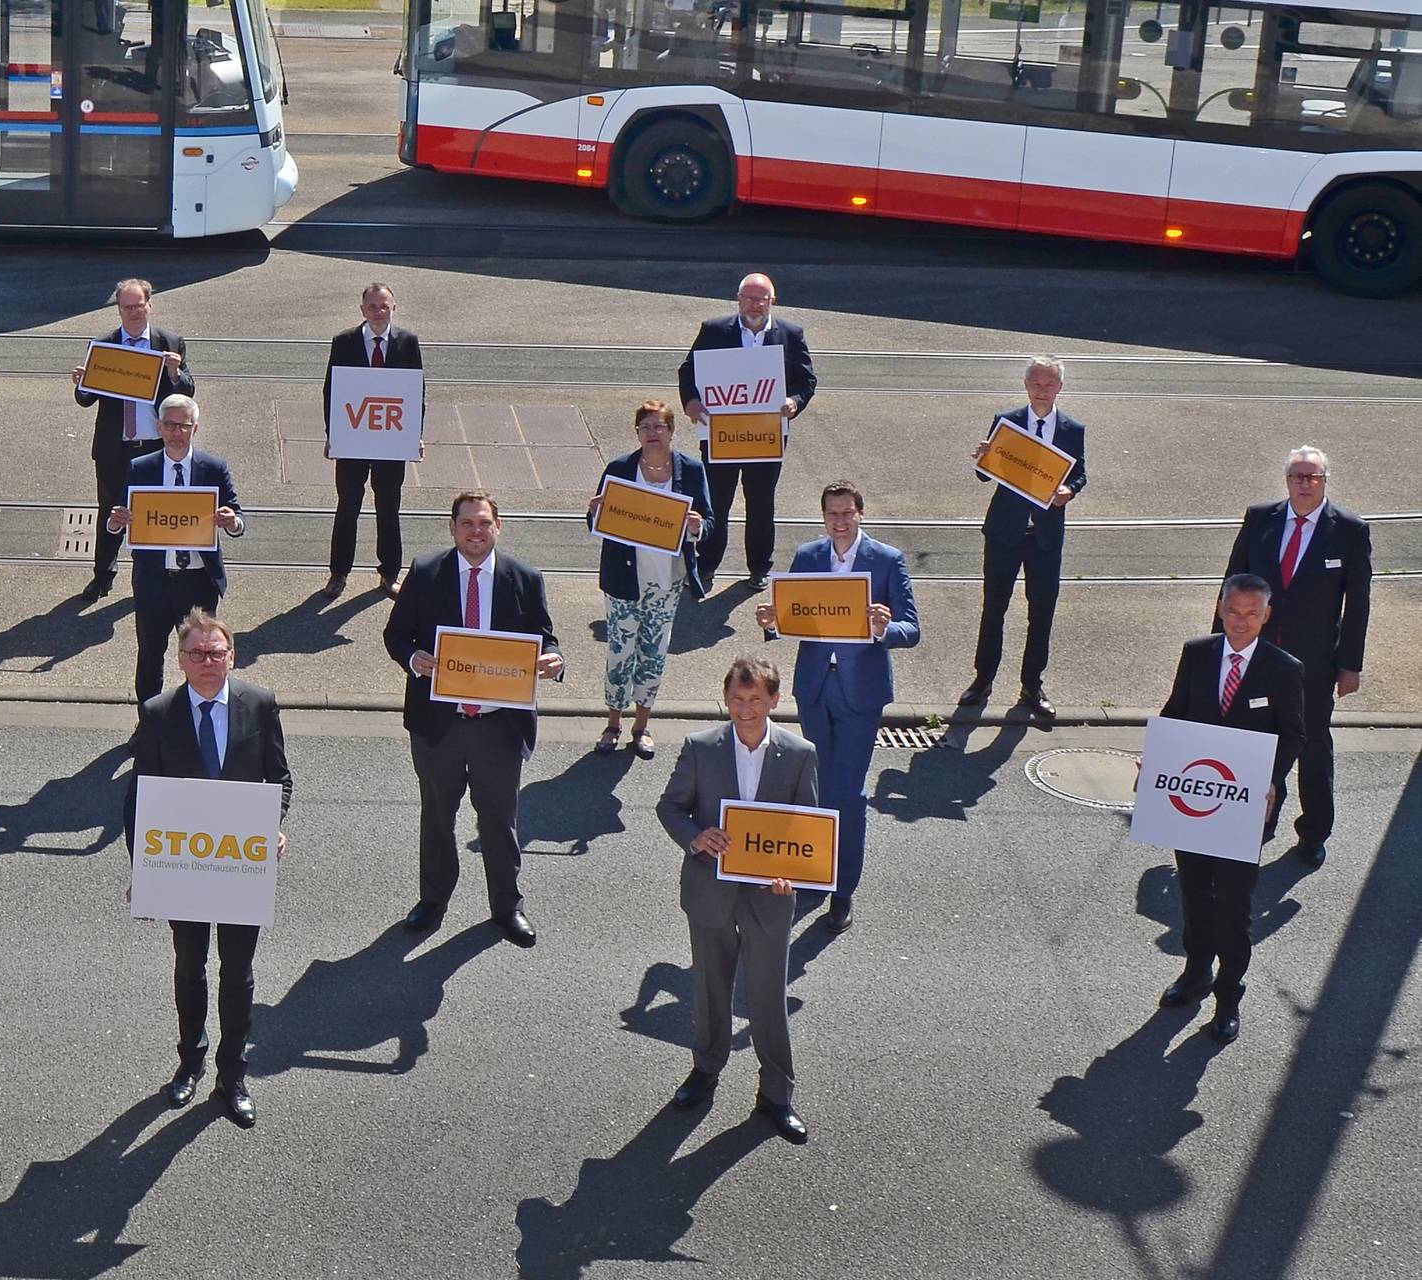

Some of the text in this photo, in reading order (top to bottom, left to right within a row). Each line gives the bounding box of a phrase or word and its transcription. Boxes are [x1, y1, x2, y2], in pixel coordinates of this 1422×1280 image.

[345, 397, 404, 431] VER
[719, 430, 776, 444] Duisburg
[995, 446, 1054, 482] Gelsenkirchen
[147, 510, 199, 529] Hagen
[609, 505, 675, 529] Metropole Ruhr
[791, 602, 851, 616] Bochum
[446, 659, 527, 679] Oberhausen
[1155, 773, 1249, 803] BOGESTRA
[144, 829, 268, 862] STOAG
[745, 832, 813, 857] Herne
[142, 858, 267, 875] Stadtwerke Oberhausen GmbH
